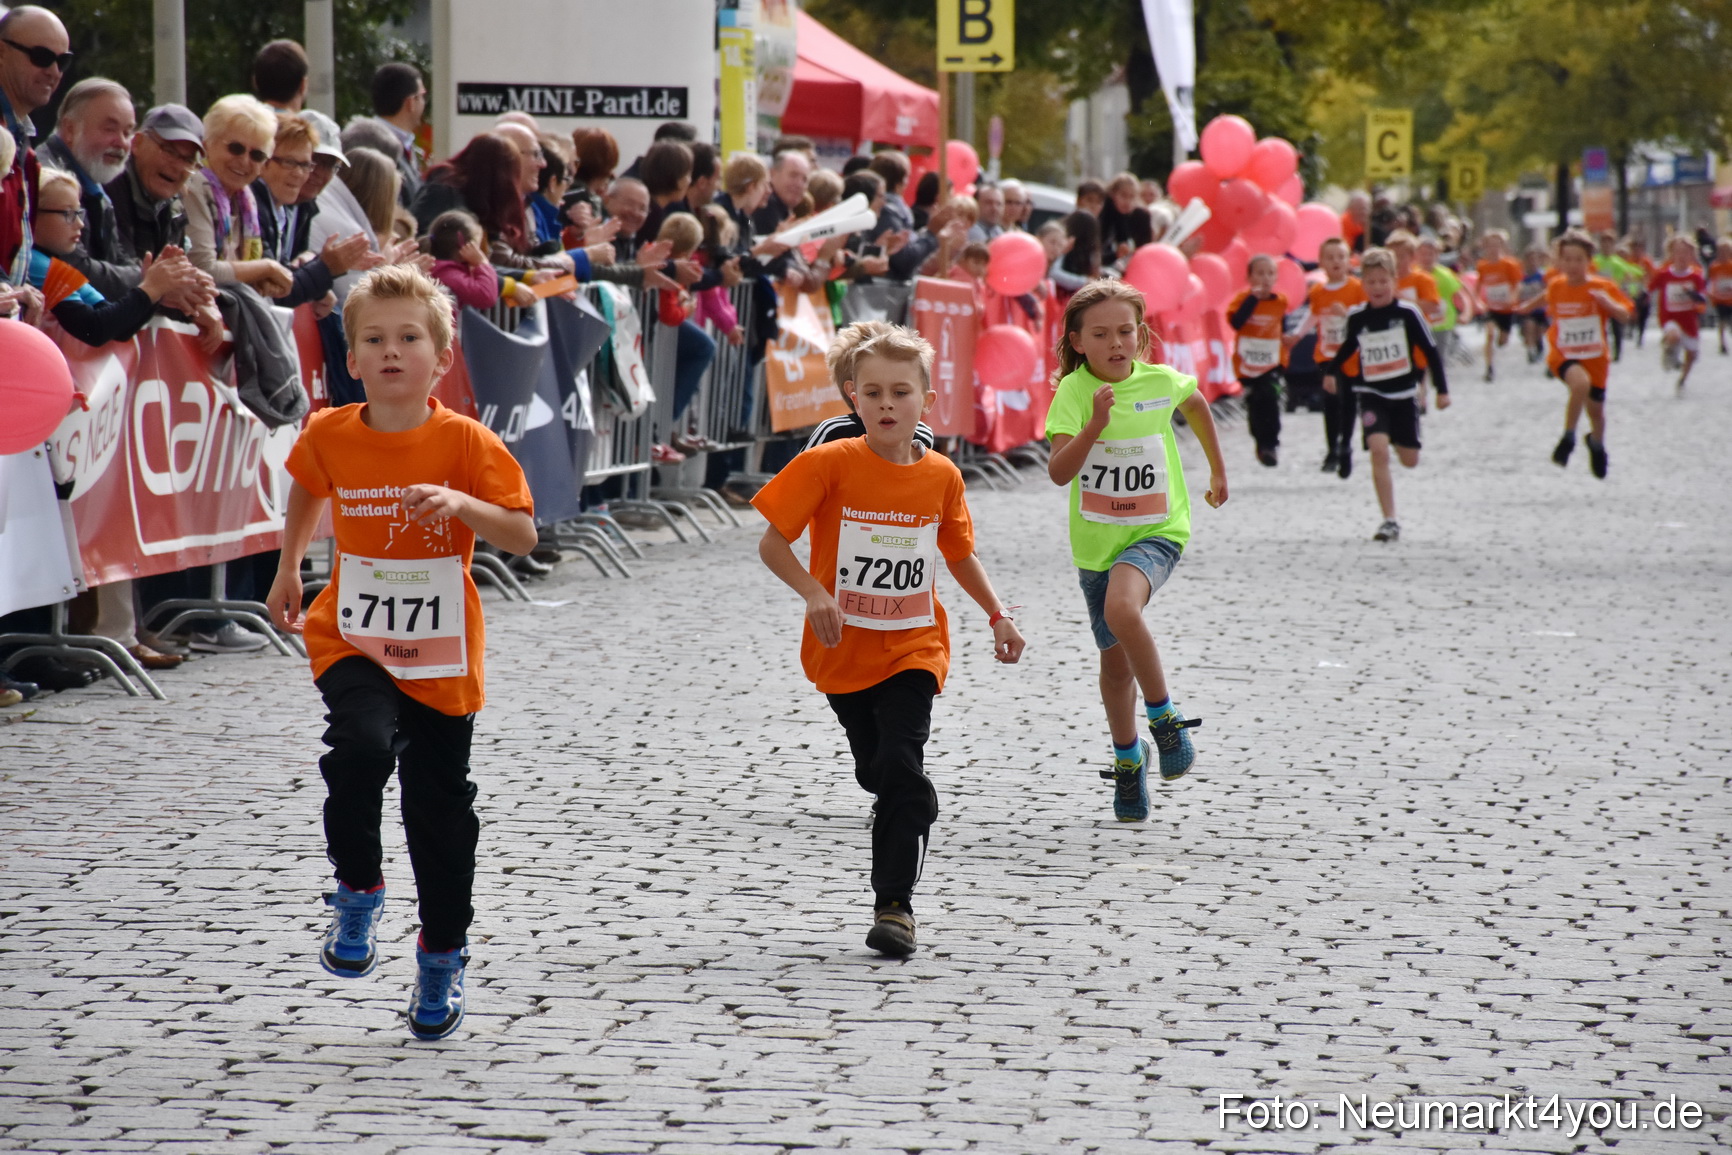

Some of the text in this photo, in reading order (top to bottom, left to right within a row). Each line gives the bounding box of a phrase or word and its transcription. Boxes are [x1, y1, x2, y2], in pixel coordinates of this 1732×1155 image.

[958, 0, 994, 45] B
[458, 87, 681, 116] www.MINI-Partl.de
[1377, 130, 1399, 161] C
[1460, 167, 1477, 191] D
[1365, 344, 1400, 362] 7013
[1092, 464, 1155, 492] 7106
[336, 485, 406, 500] Neumarkte
[340, 503, 400, 518] Stadtlauf
[842, 506, 917, 523] Neumarkter
[1111, 501, 1136, 511] Linus
[882, 536, 918, 547] BOCK
[385, 571, 430, 581] BOCK
[854, 556, 925, 591] 7208
[358, 593, 440, 632] 7171
[845, 593, 905, 616] FELIX
[384, 643, 419, 659] Kilian
